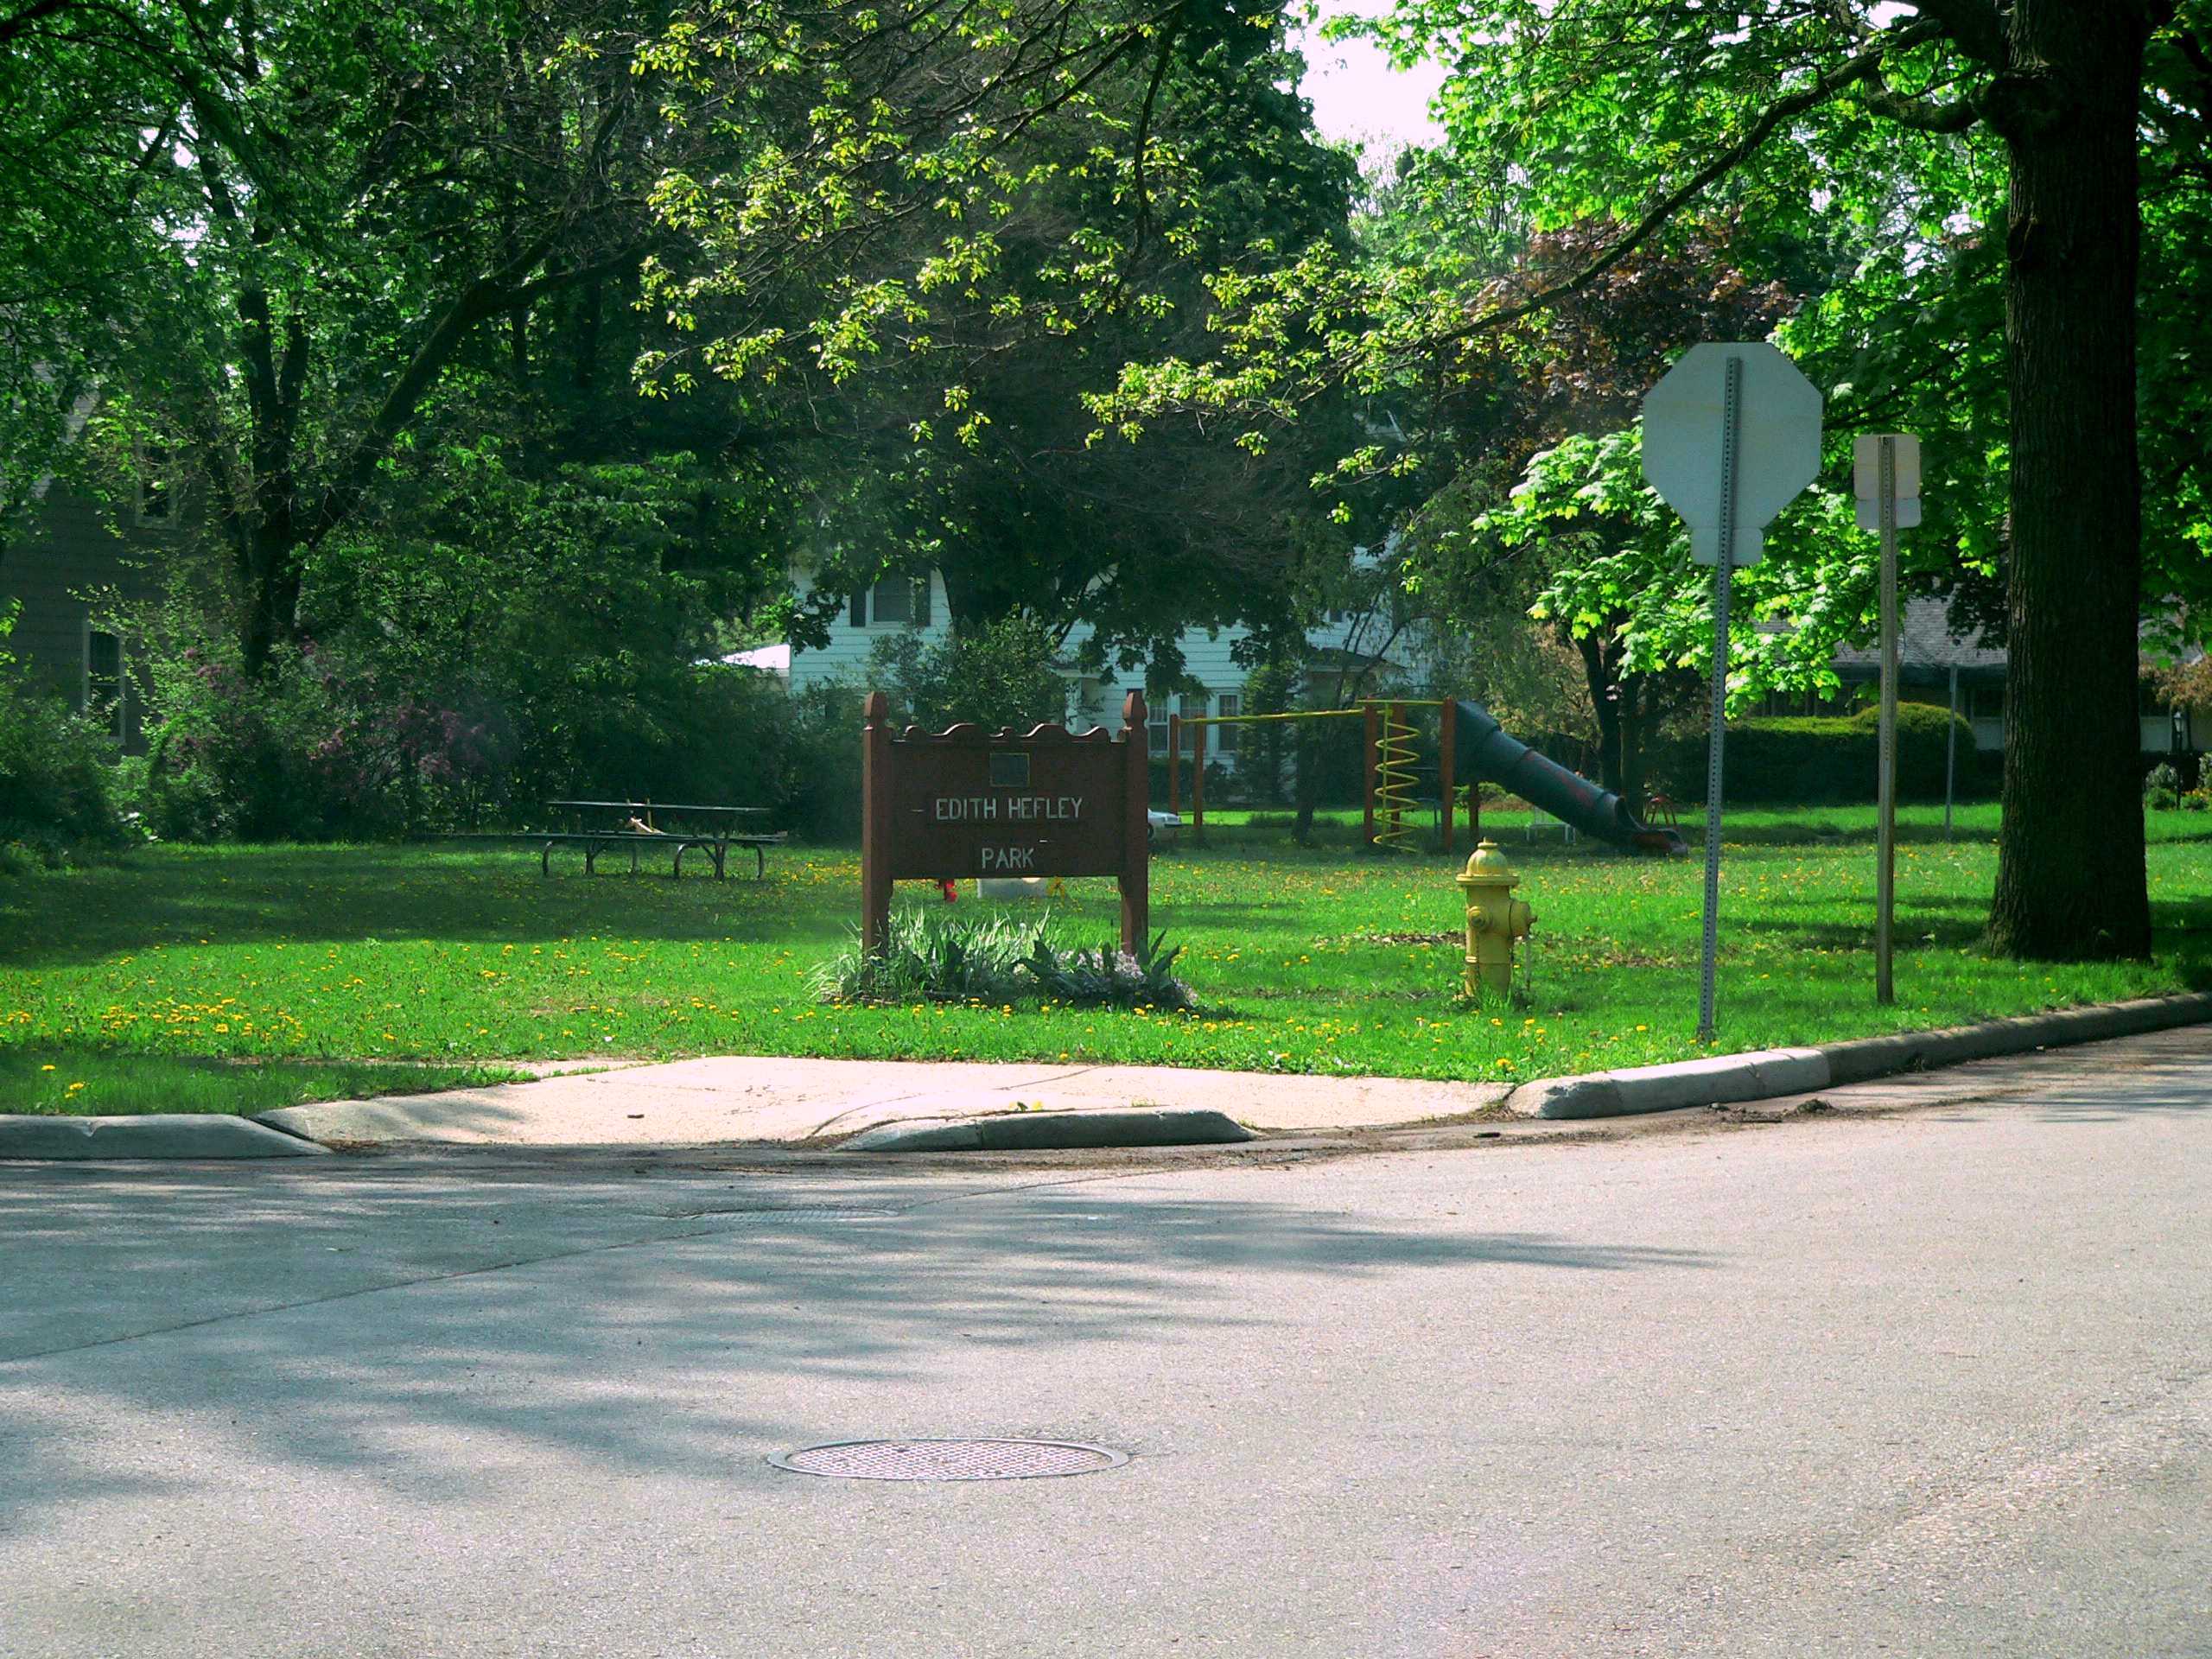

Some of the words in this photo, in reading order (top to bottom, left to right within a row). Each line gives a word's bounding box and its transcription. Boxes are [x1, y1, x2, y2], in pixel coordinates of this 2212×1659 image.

[936, 798, 996, 820] EDITH
[1008, 798, 1082, 819] HEFLEY
[982, 848, 1034, 869] PARK
